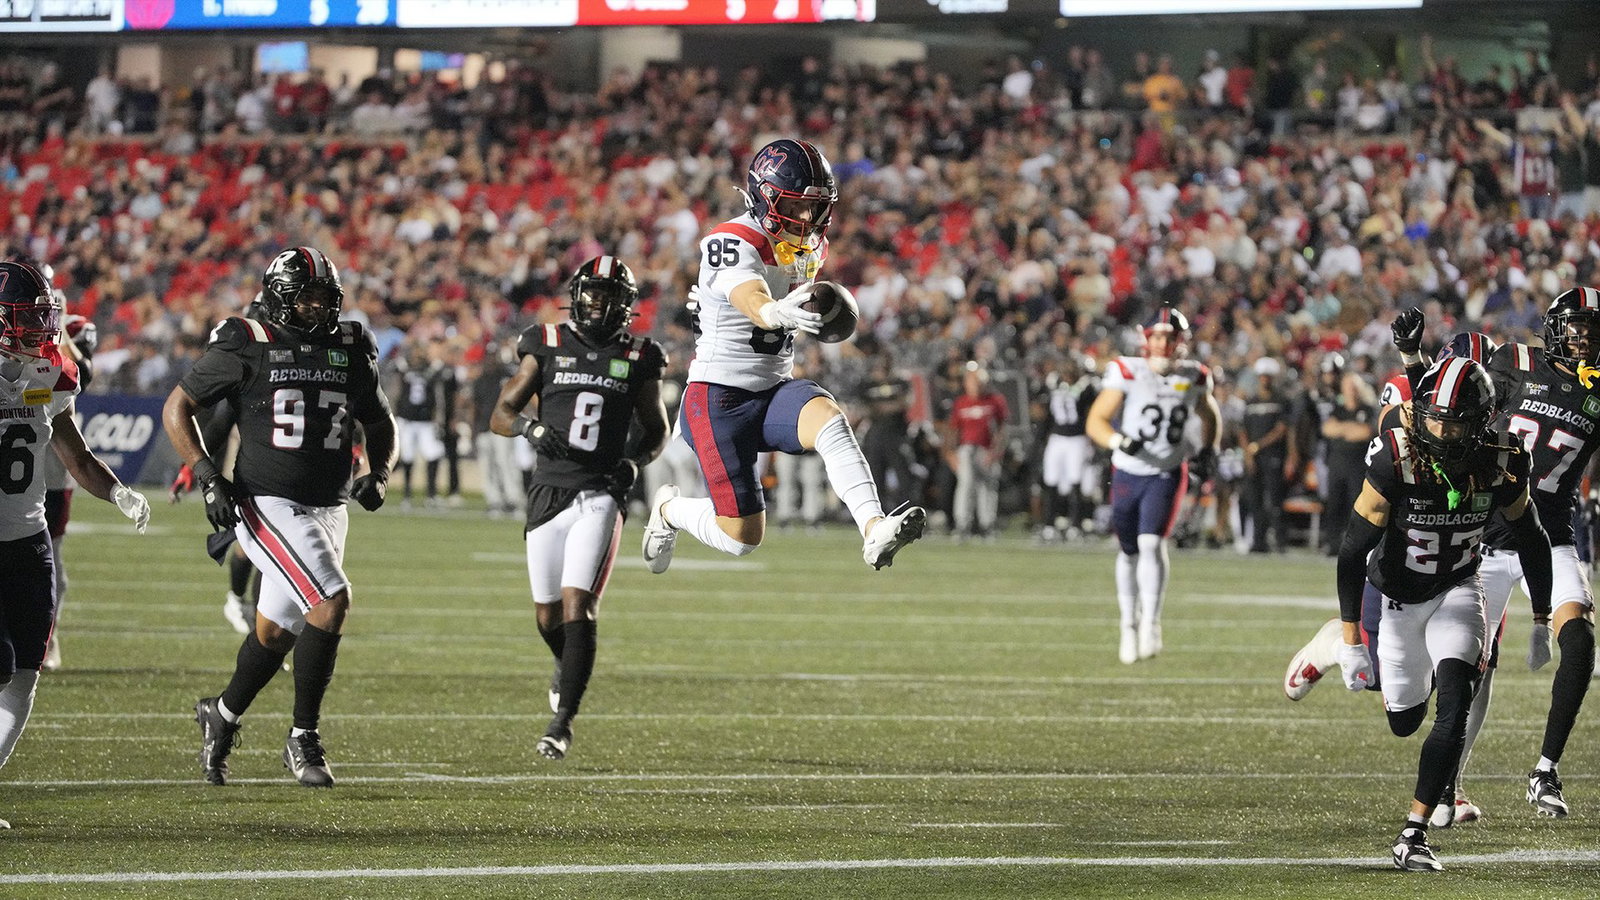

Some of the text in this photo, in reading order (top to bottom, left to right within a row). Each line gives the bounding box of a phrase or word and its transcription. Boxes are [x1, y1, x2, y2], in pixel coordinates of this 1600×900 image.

[707, 238, 740, 267] 85
[331, 351, 346, 363] TD
[268, 368, 348, 384] REDBLACKS
[553, 371, 629, 393] REDBLACKS
[84, 412, 154, 453] GOLD
[273, 388, 348, 449] 97
[568, 391, 604, 451] 8
[1138, 404, 1189, 444] 38
[1519, 398, 1595, 435] REDBLACKS
[0, 423, 37, 495] 6
[1406, 511, 1489, 525] REDBLACKS
[1476, 496, 1490, 507] TD
[1405, 527, 1485, 575] 27
